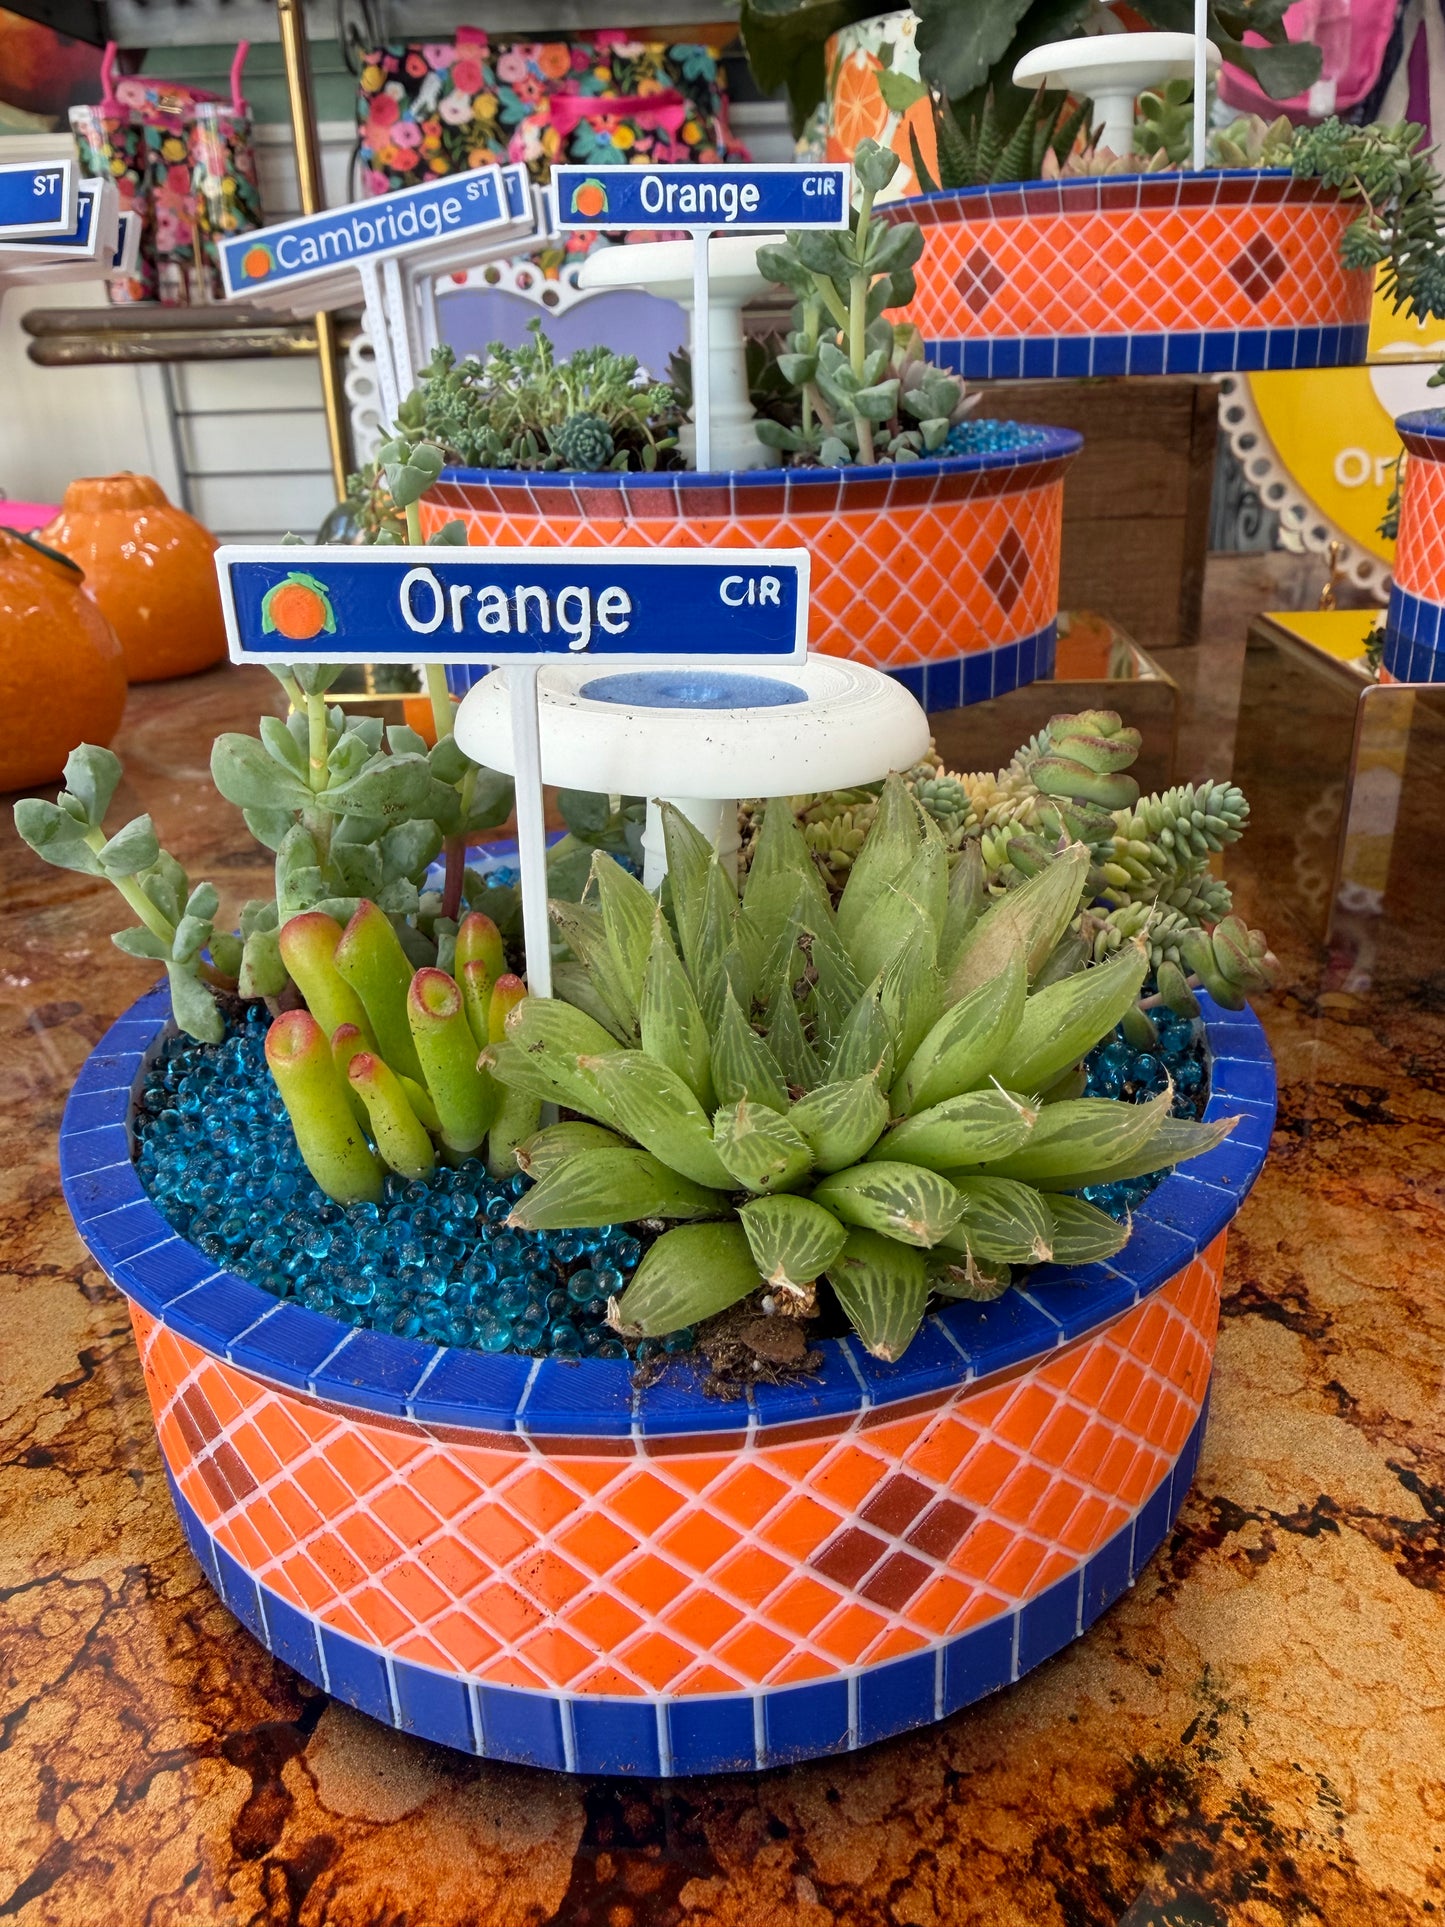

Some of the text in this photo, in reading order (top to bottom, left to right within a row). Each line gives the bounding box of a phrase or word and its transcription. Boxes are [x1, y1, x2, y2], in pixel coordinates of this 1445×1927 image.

[33, 173, 60, 196] ST
[505, 176, 516, 195] T
[640, 175, 836, 222] Orange CIR
[78, 197, 90, 219] T
[276, 178, 490, 270] Cambridge ST
[1334, 447, 1405, 488] Or
[399, 567, 781, 651] Orange CIR
